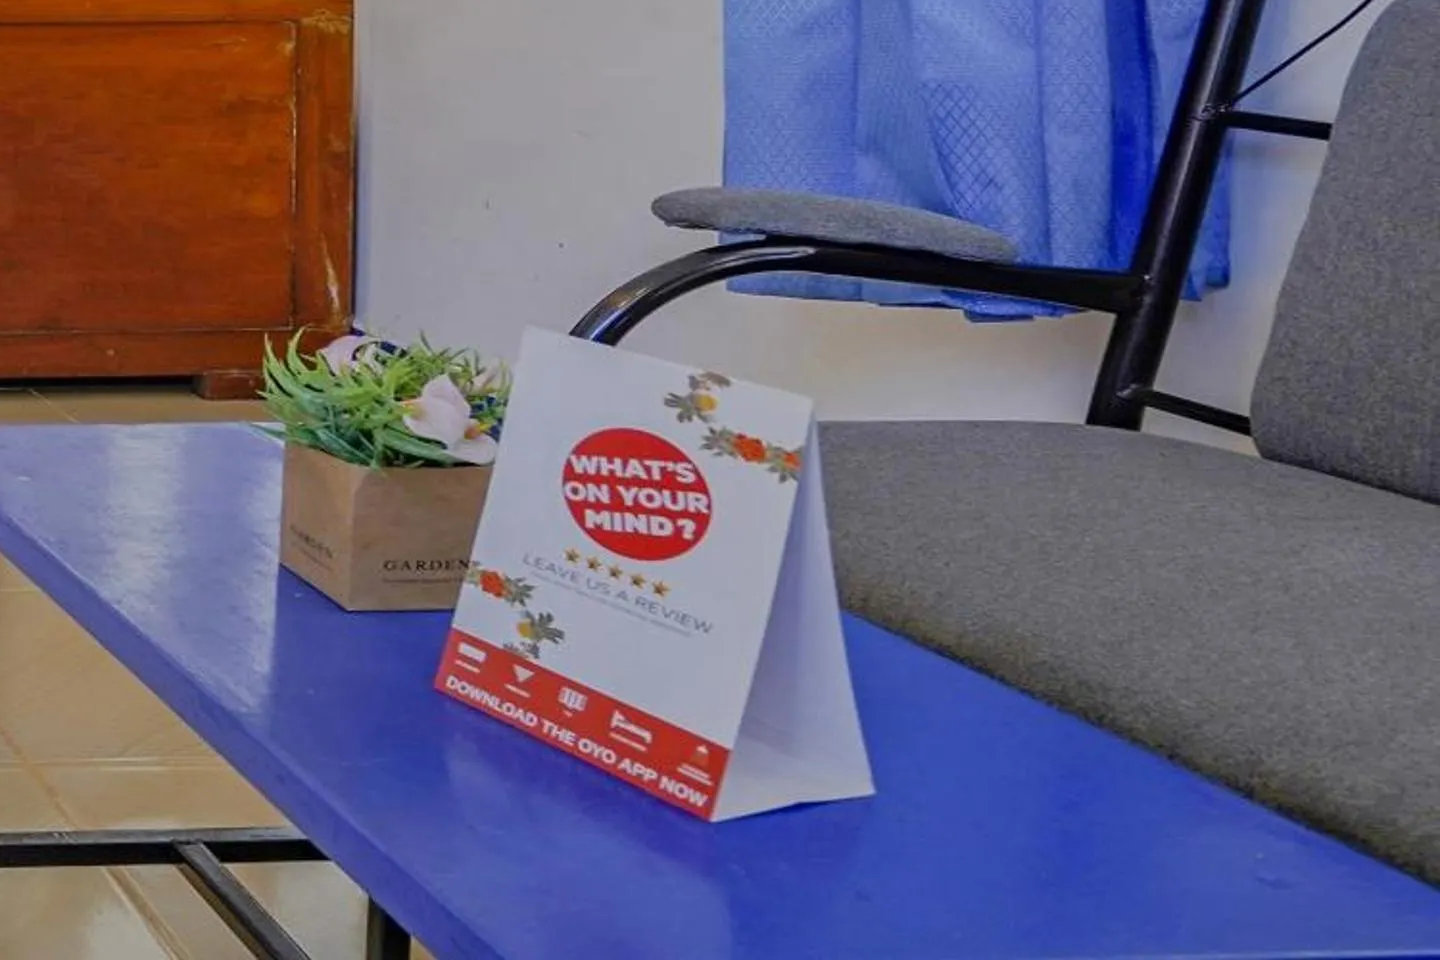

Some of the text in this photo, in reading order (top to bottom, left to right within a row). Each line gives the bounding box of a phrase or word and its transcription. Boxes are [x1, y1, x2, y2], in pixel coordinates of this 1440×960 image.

[570, 455, 696, 484] WHAT'S
[565, 481, 709, 514] ON YOUR
[584, 509, 696, 540] MIND?
[523, 553, 713, 634] LEAVE US A REVIEW
[446, 675, 708, 807] DOWNLOAD THE OYO APP NOW
